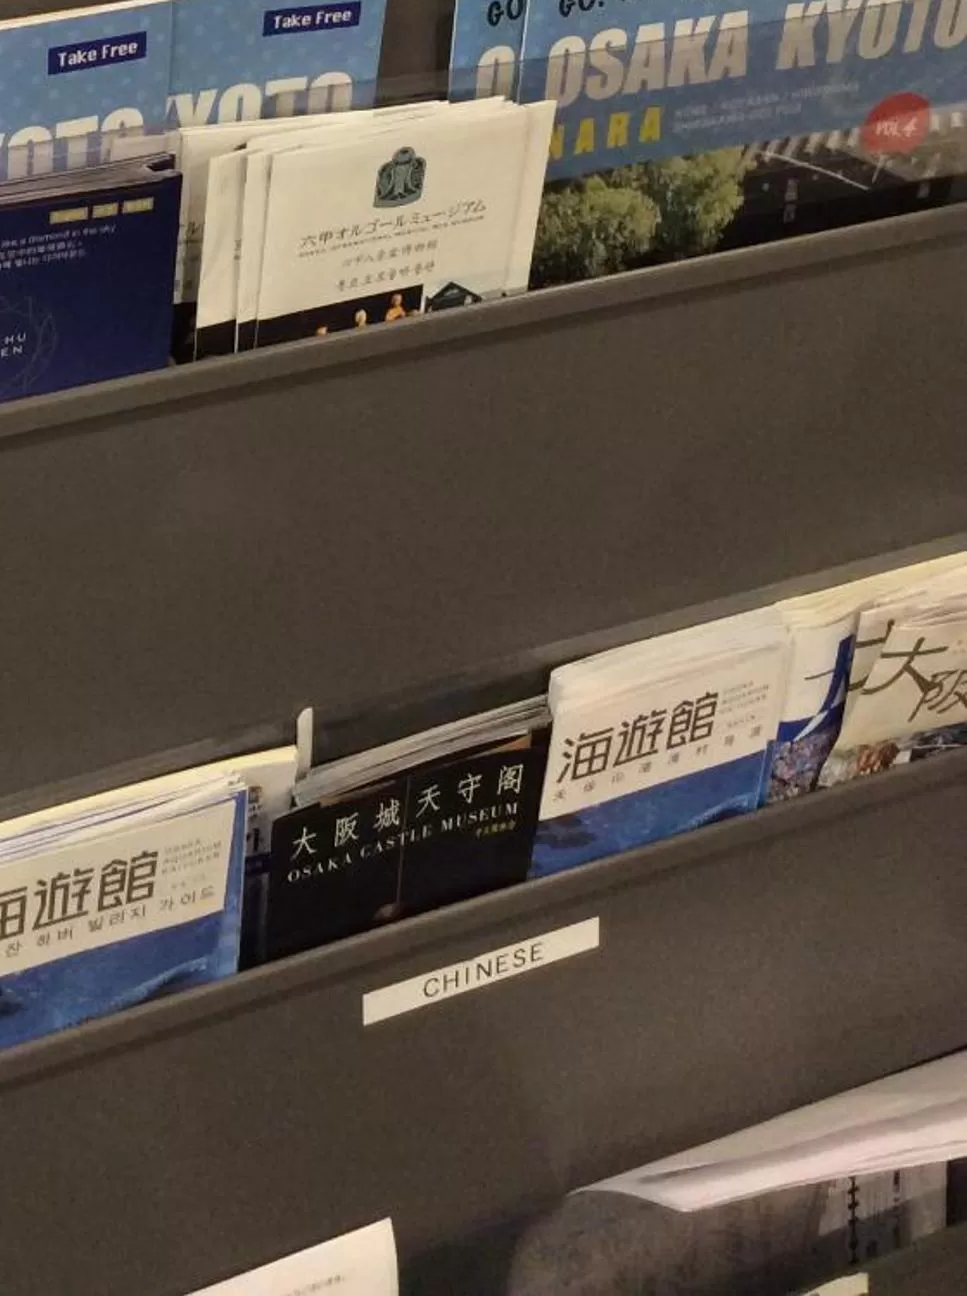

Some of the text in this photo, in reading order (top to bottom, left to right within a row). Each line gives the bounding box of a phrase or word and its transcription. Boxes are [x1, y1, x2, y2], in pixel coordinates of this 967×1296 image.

[273, 7, 353, 31] Take Free
[57, 40, 138, 69] Take Free
[545, 9, 750, 108] OSAKA
[556, 691, 719, 784] 海遊館
[286, 853, 352, 883] OSAKA
[359, 825, 433, 858] CASTLE
[440, 802, 519, 833] MUSEUM
[422, 941, 546, 999] CHINESE
